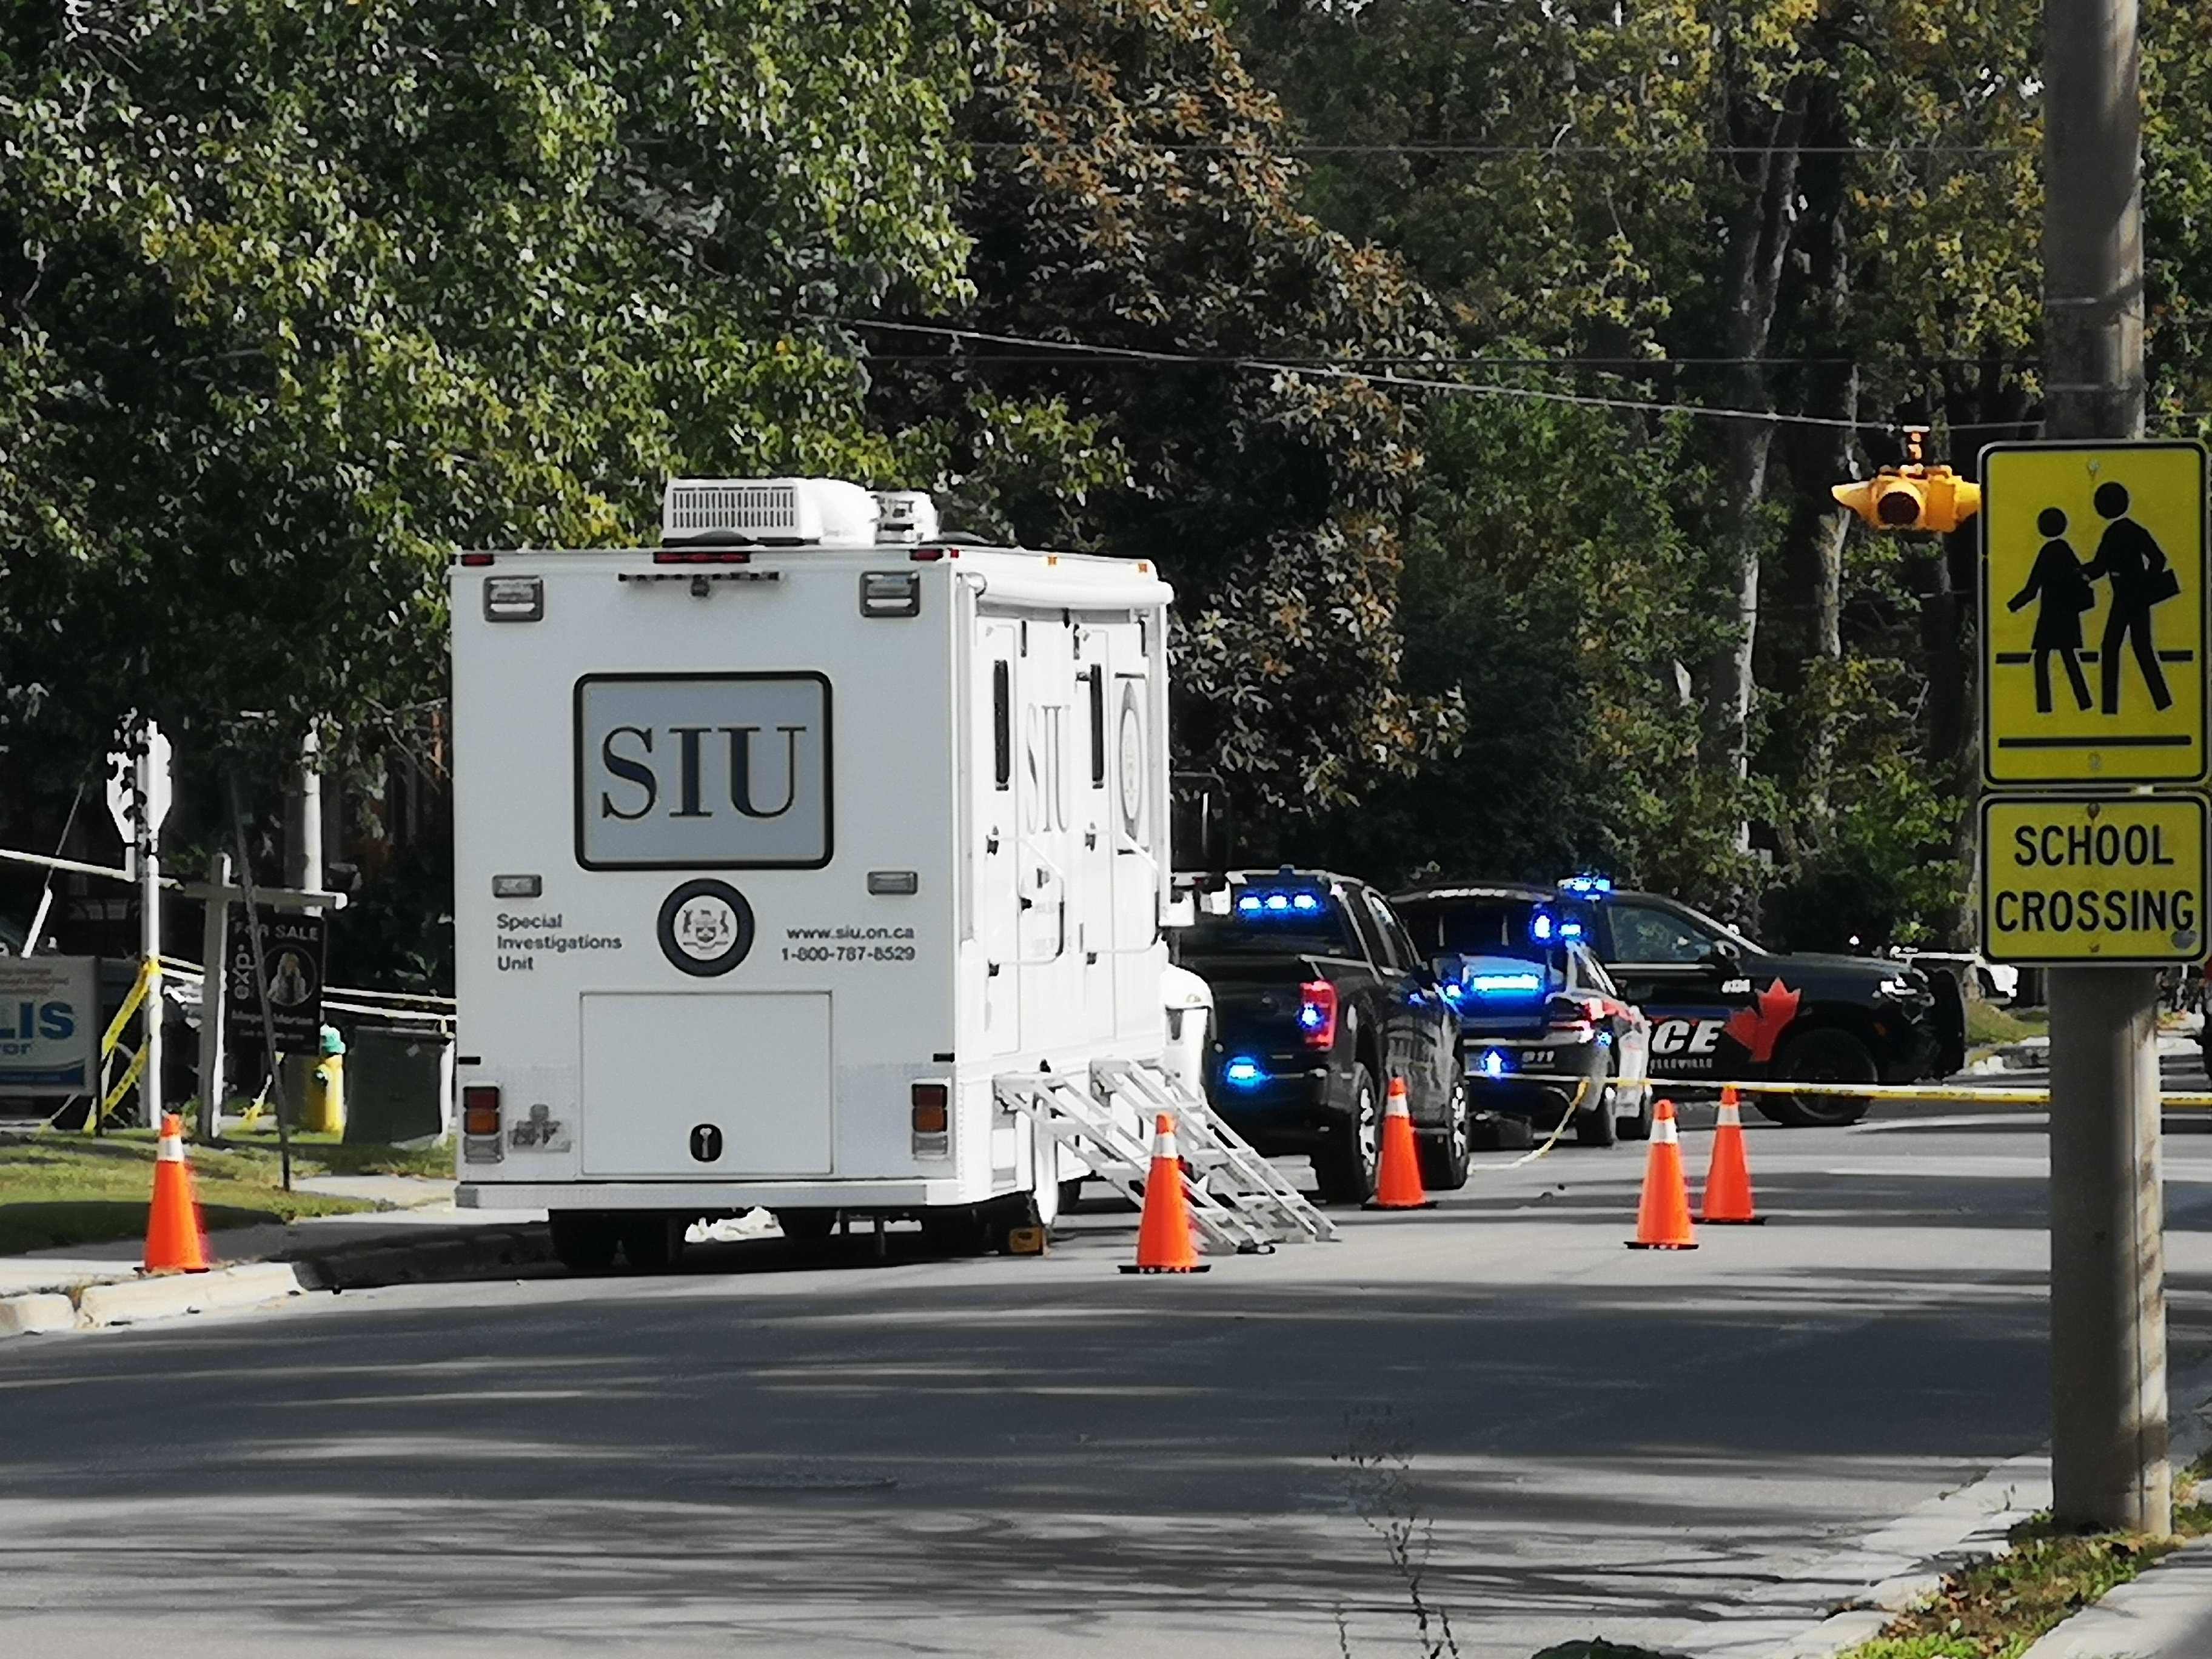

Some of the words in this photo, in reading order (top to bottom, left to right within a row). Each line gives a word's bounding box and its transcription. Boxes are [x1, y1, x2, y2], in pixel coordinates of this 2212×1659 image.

[602, 726, 807, 820] SIU
[2014, 825, 2174, 866] SCHOOL
[1996, 890, 2194, 931] CROSSING
[497, 913, 563, 931] Special
[275, 924, 320, 940] SALE
[786, 925, 914, 939] www.siu.on.ca
[497, 934, 623, 953] Investigations
[781, 946, 916, 962] 1-800-787-8529
[497, 955, 534, 971] Unit
[0, 1042, 32, 1055] or
[1522, 1050, 1555, 1063] 911
